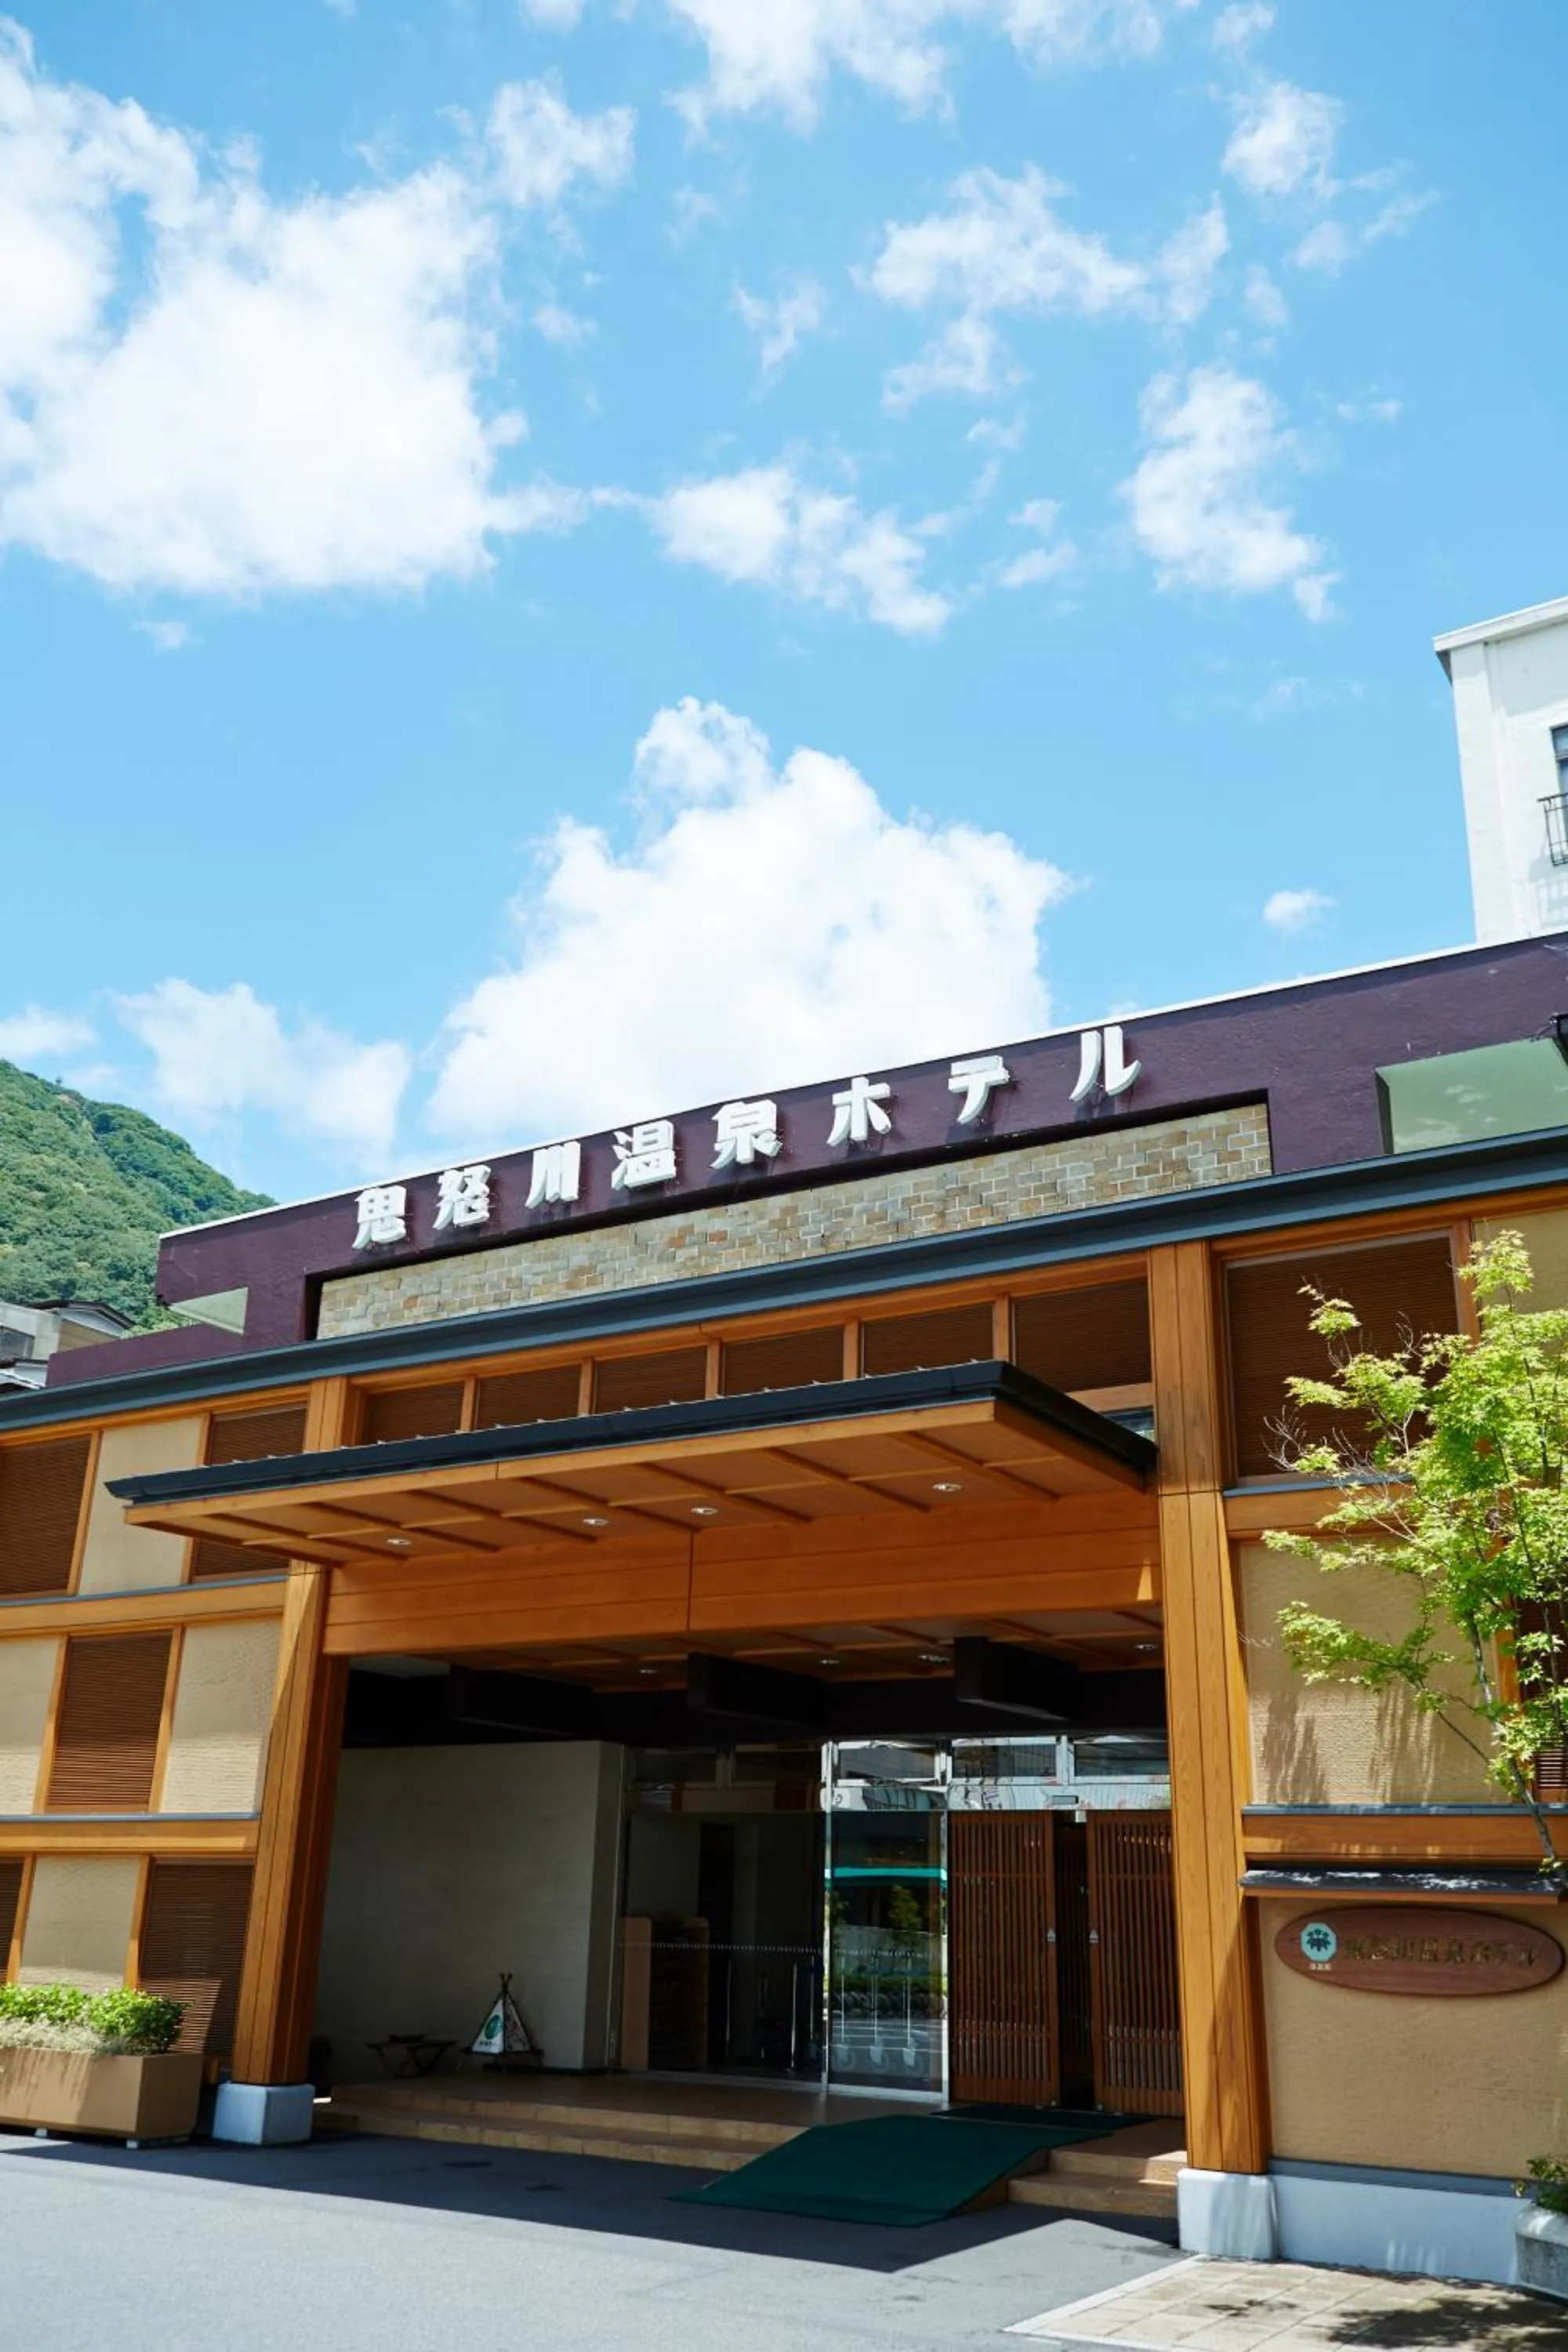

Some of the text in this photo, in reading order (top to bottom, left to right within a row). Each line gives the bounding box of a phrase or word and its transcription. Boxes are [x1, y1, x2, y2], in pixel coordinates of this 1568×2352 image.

[352, 1025, 1142, 1250] 鬼怒川温泉ホテル
